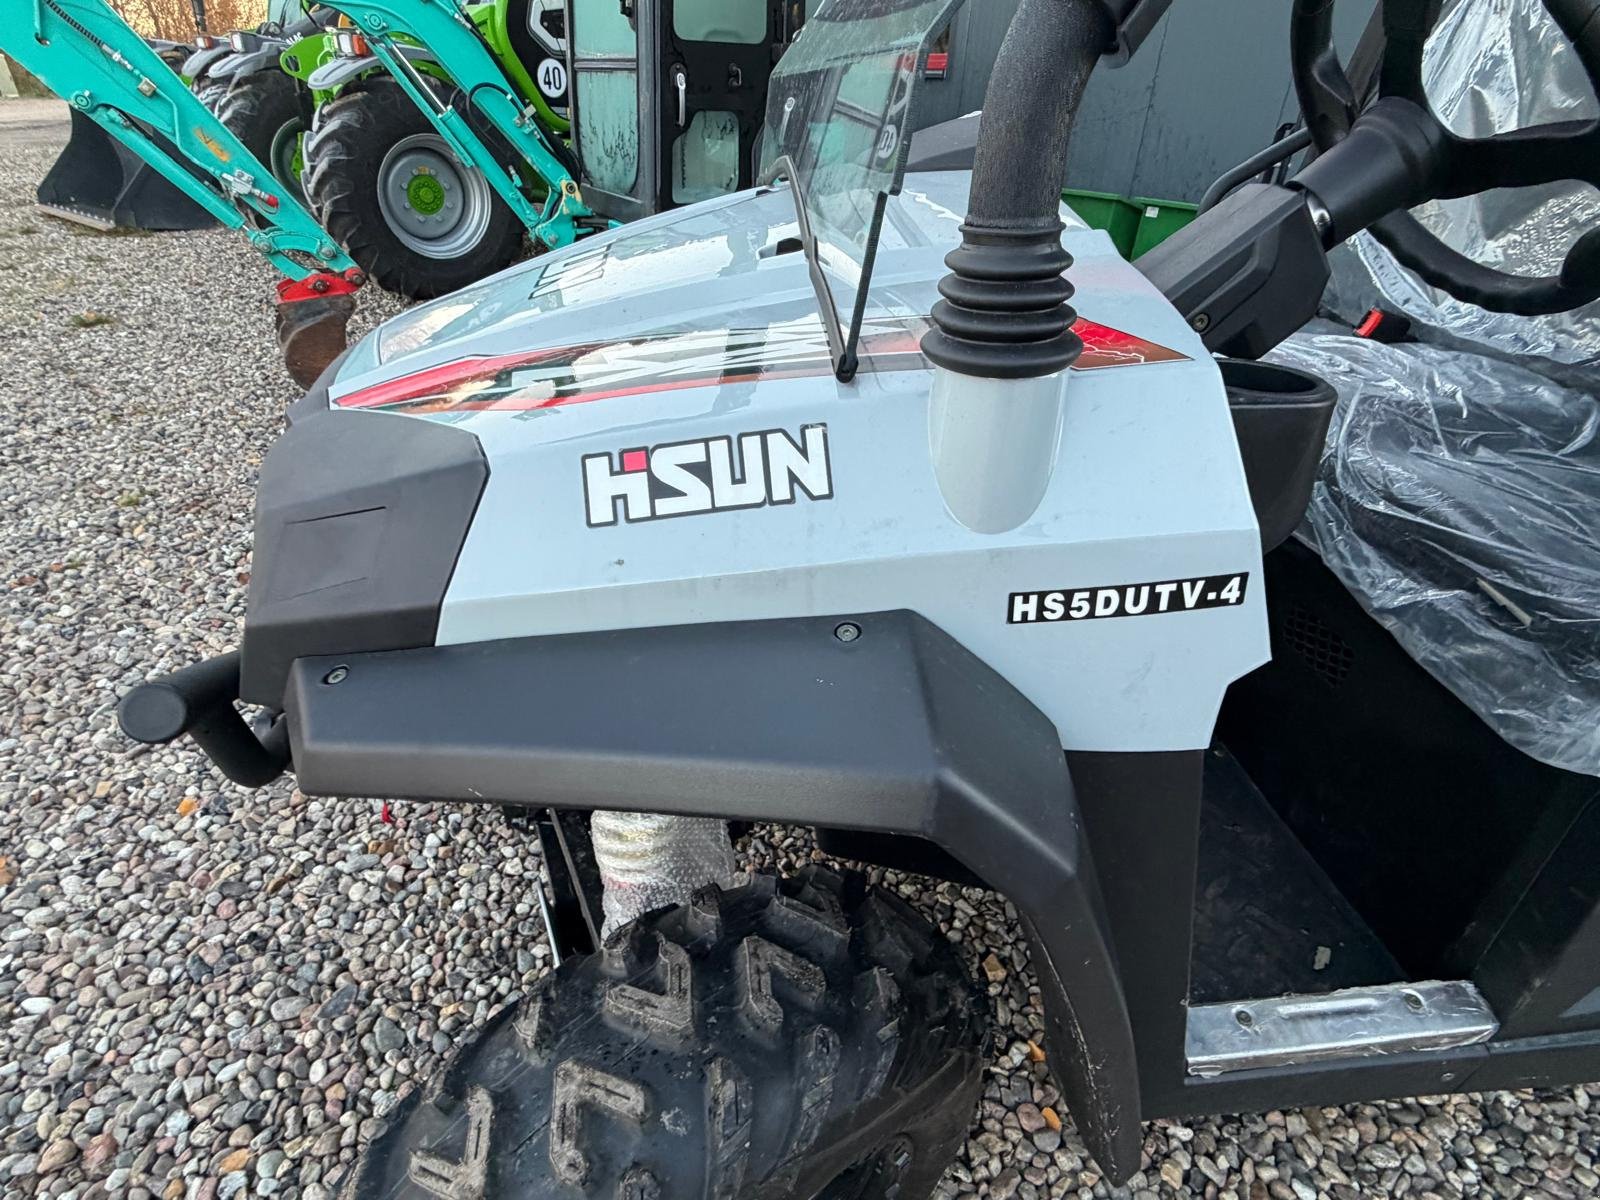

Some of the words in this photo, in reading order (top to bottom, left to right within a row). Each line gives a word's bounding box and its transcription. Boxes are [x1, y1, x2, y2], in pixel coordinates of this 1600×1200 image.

[543, 66, 562, 90] 40
[582, 423, 833, 527] HSUN
[1012, 576, 1242, 622] HS5DUTV-4
